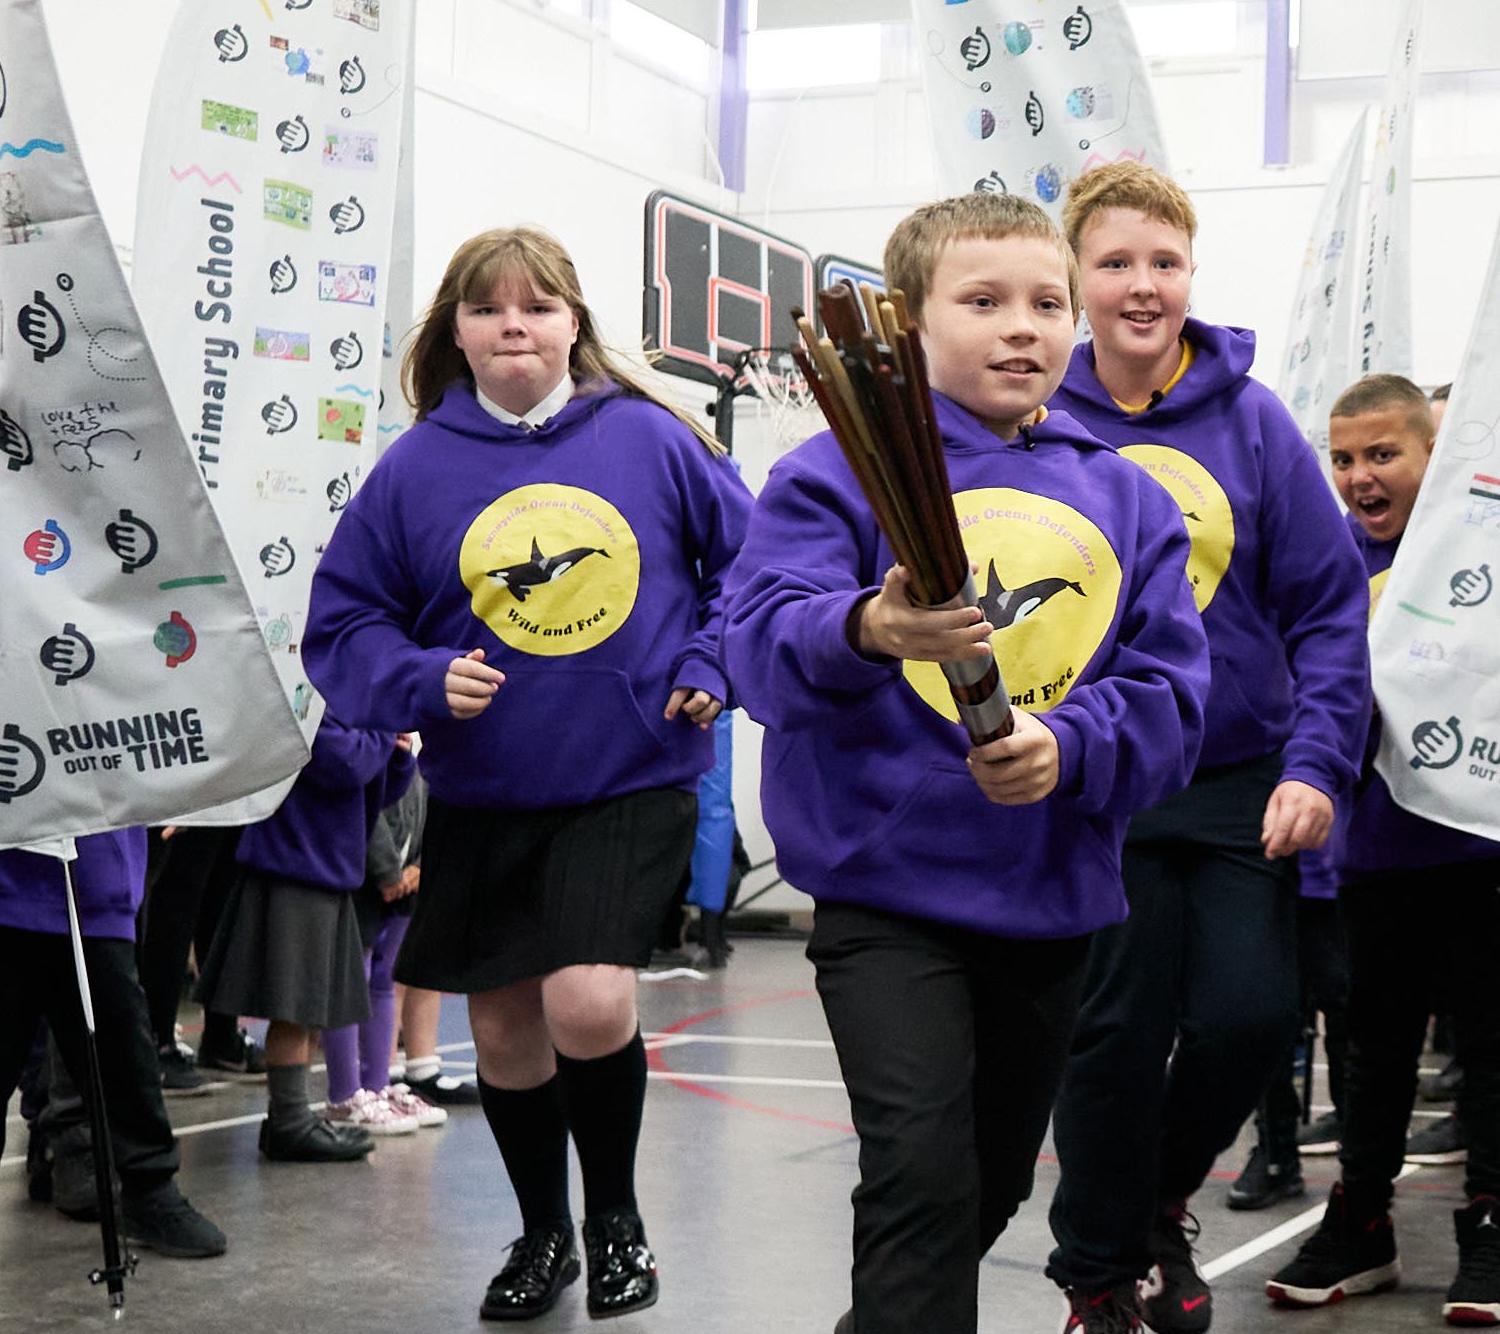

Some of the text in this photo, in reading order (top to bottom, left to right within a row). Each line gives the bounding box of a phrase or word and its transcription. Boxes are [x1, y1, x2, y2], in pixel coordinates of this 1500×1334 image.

[195, 198, 235, 324] School
[482, 499, 618, 550] Sunnyside Ocean Defenders
[983, 508, 1097, 577] Ocean Defenders
[506, 606, 608, 637] Wild and Free
[1009, 666, 1075, 706] nd Free
[46, 707, 203, 756] RUNNING
[64, 735, 210, 774] OUT OF TIME
[1468, 763, 1497, 782] OUT
